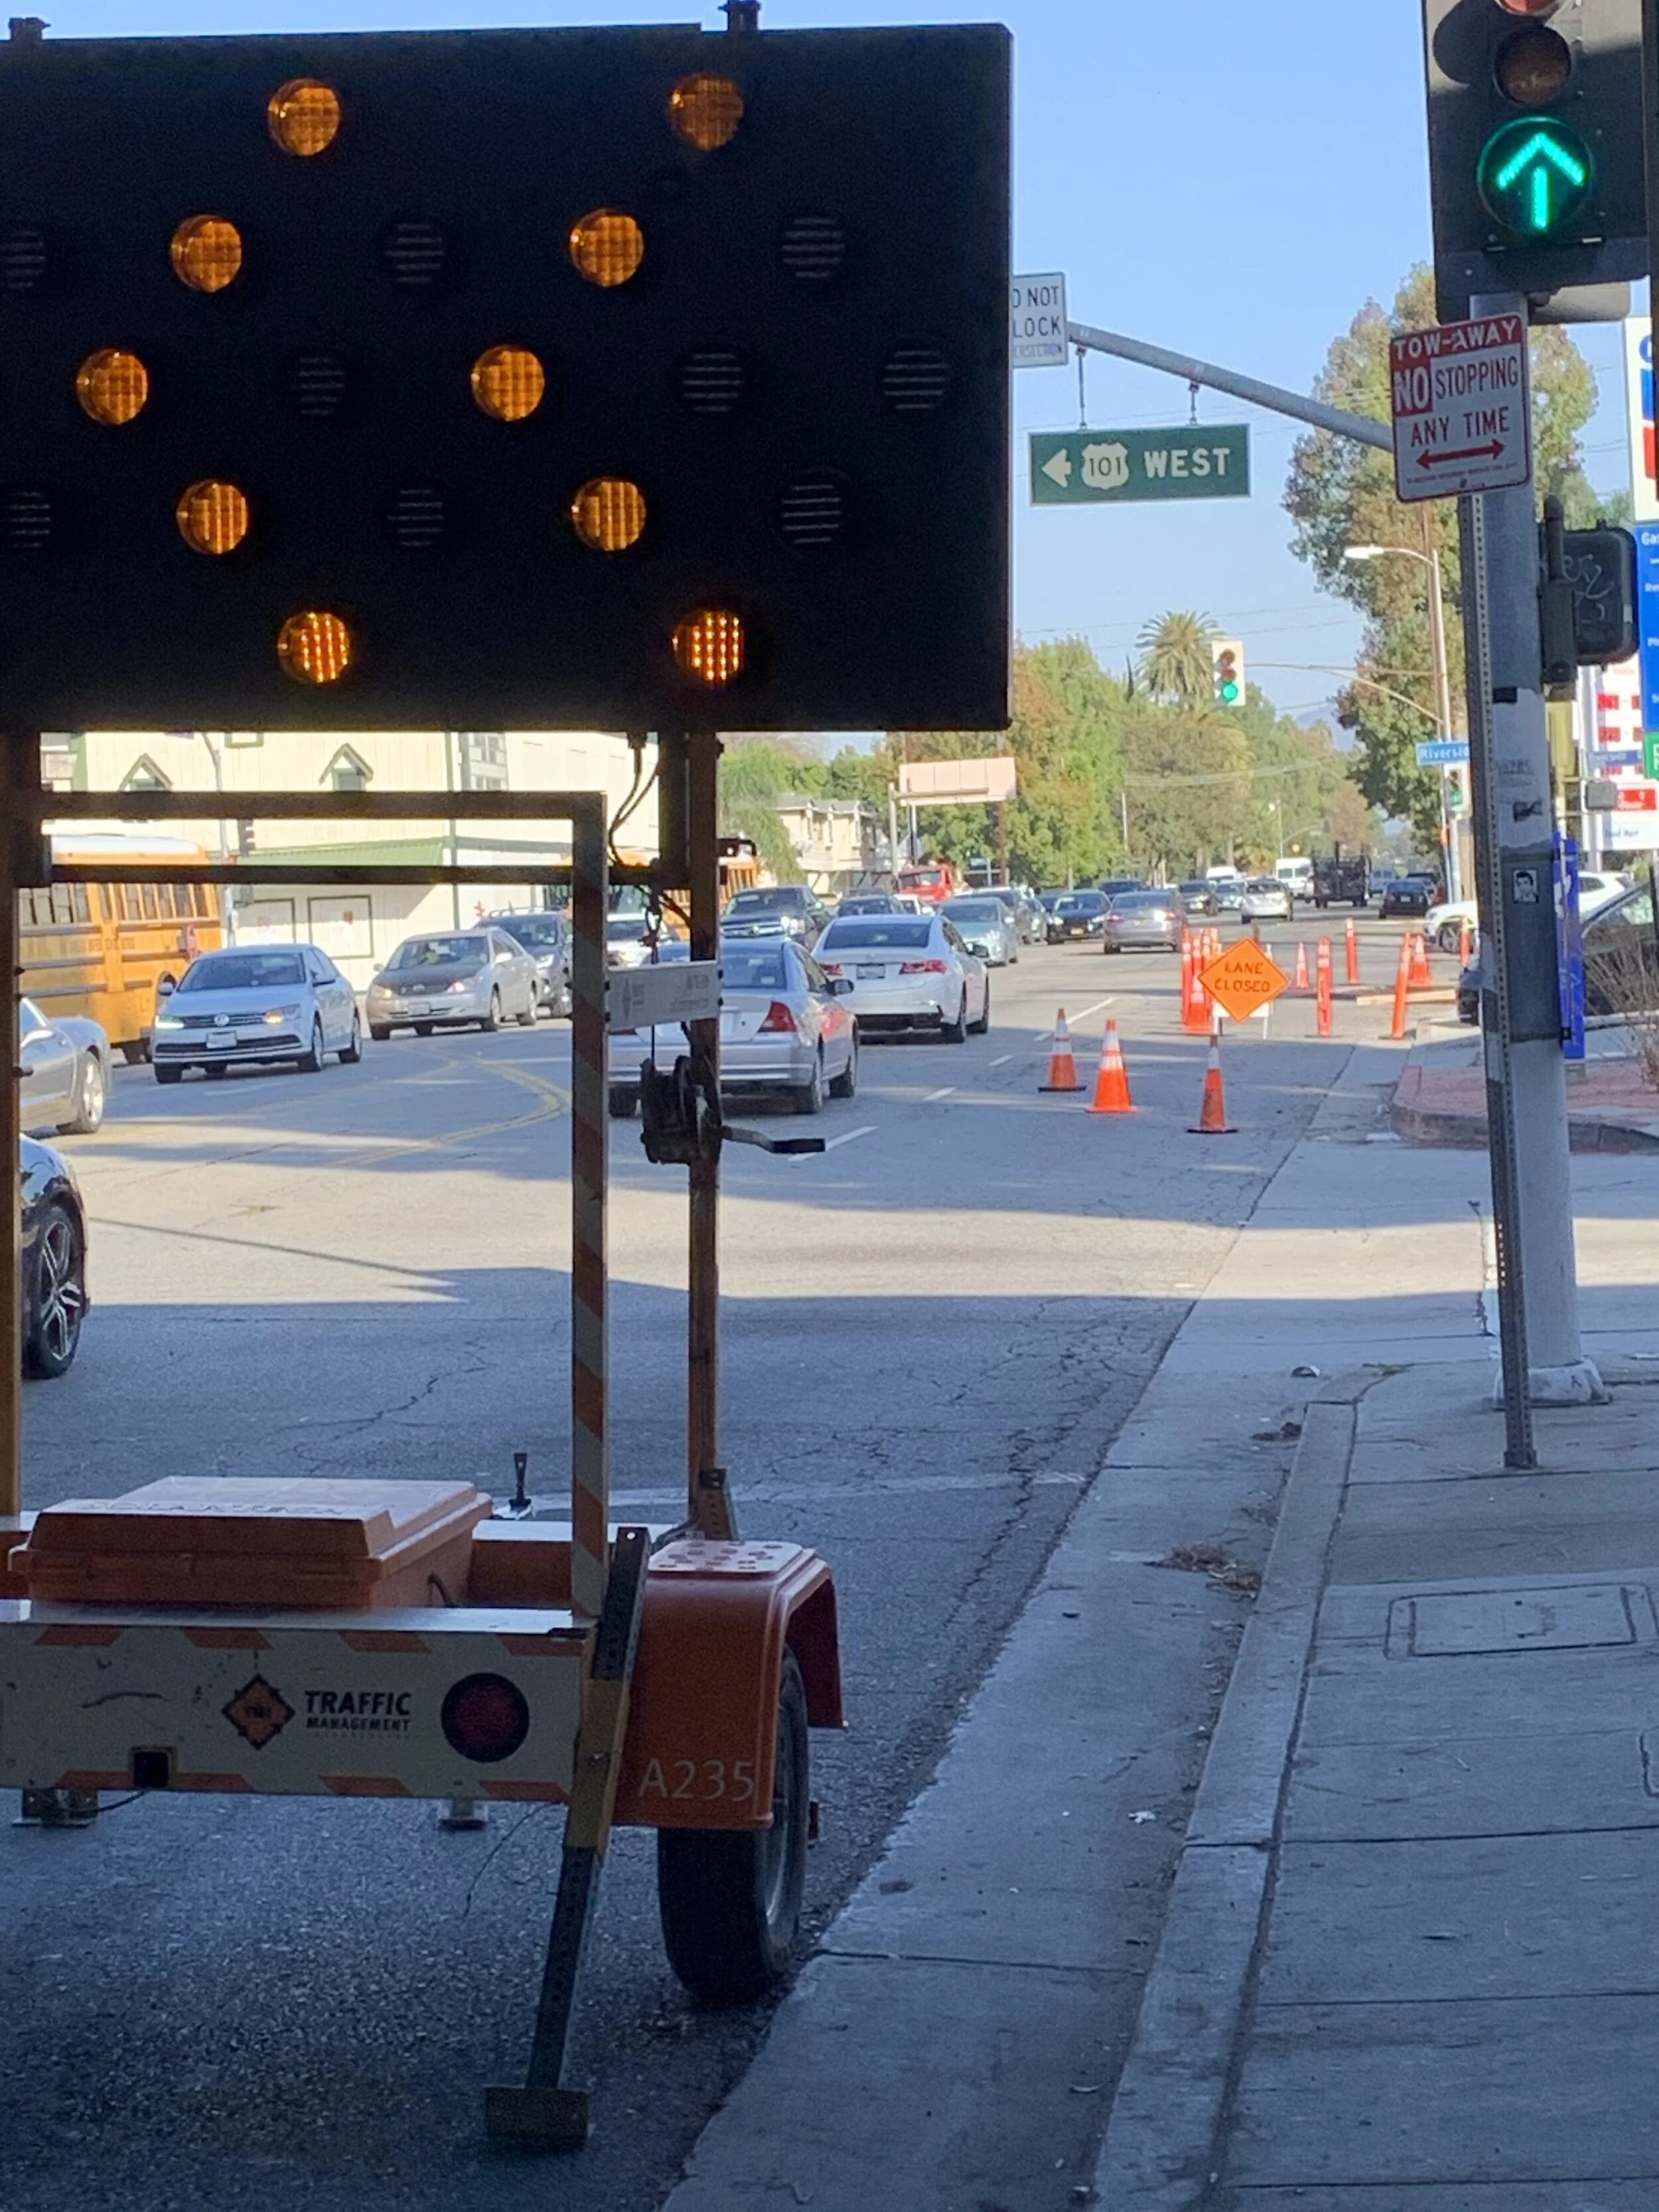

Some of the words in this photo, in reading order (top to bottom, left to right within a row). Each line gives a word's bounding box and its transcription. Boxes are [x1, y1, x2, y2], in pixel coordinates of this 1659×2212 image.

[1012, 288, 1021, 308] O
[1027, 285, 1060, 307] NOT
[1012, 316, 1061, 338] LOCK
[1394, 318, 1518, 361] TOW-AWAY
[1394, 366, 1427, 411] NO
[1435, 356, 1519, 400] STOPPING
[1411, 415, 1450, 447] ANY
[1463, 406, 1510, 438] TIME
[1088, 457, 1122, 477] 101
[1143, 448, 1230, 479] WEST
[1420, 745, 1469, 759] Riversid
[1224, 962, 1264, 974] LANE
[1214, 978, 1270, 992] CLOSED
[305, 1690, 412, 1716] TRAFFIC
[307, 1717, 411, 1731] MANAGEMENT
[637, 1758, 756, 1802] A235
